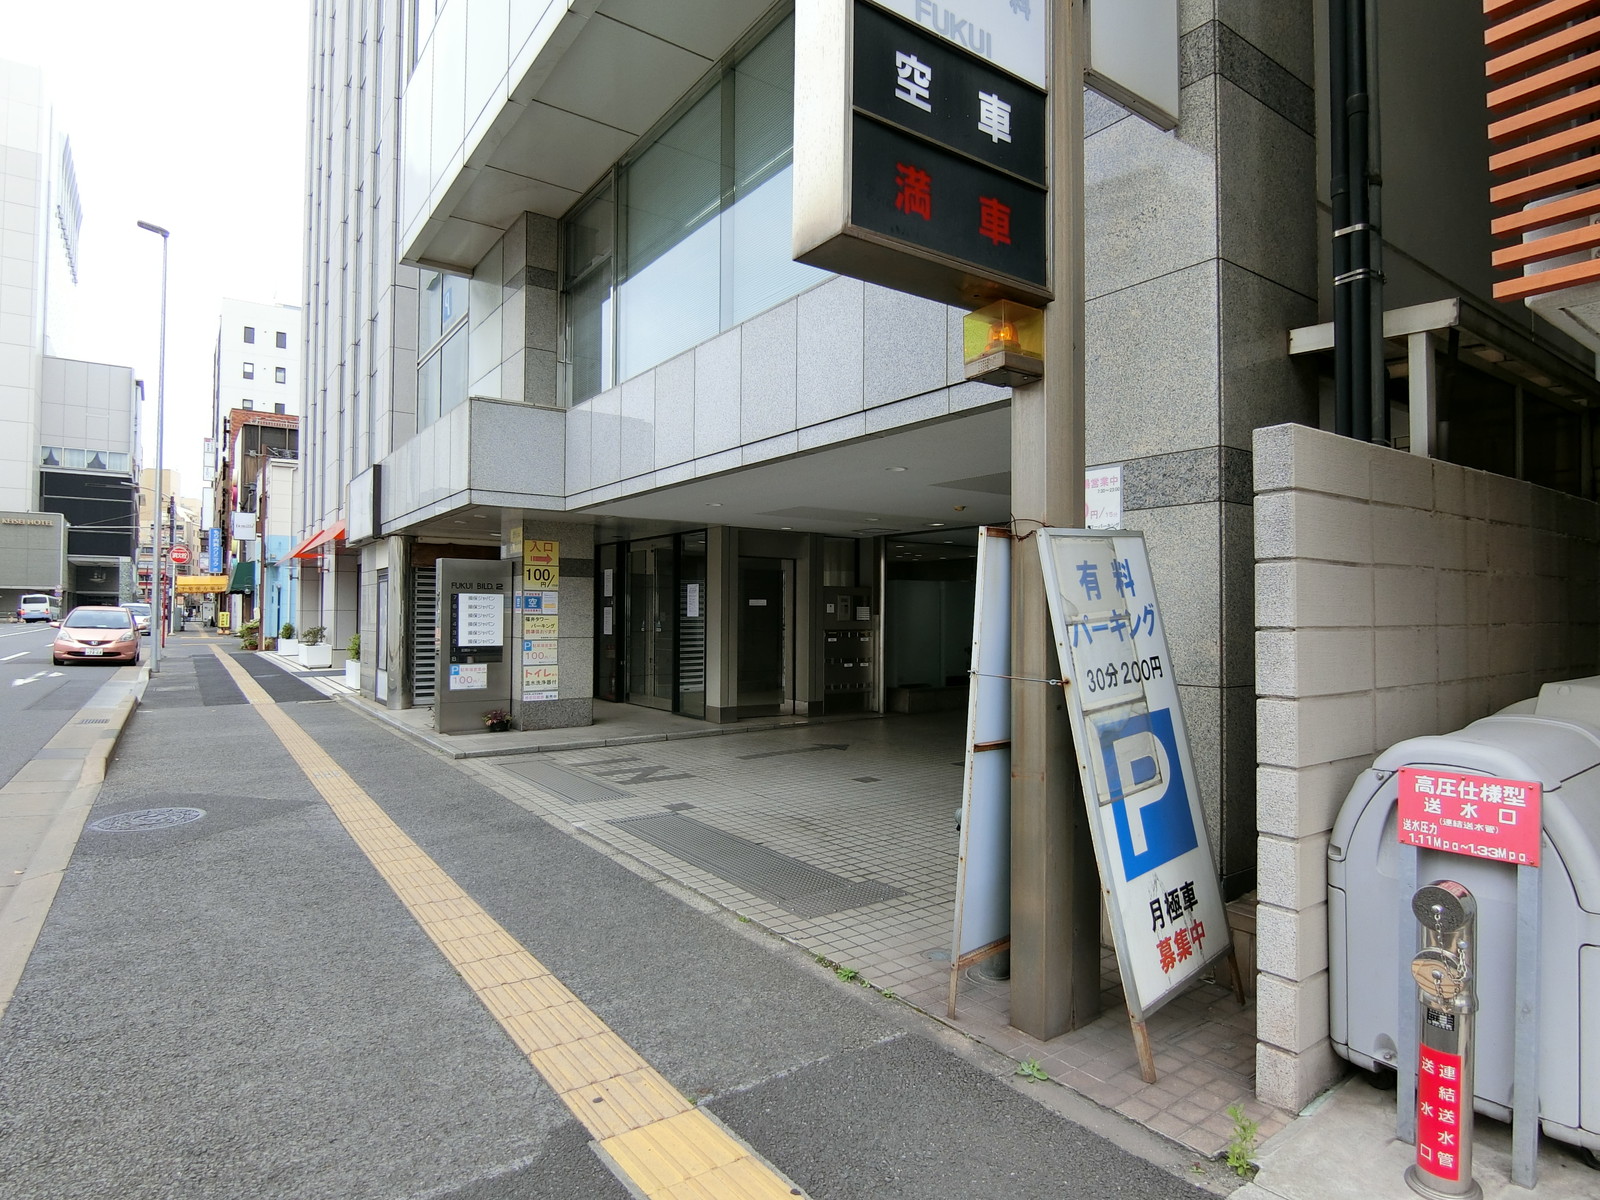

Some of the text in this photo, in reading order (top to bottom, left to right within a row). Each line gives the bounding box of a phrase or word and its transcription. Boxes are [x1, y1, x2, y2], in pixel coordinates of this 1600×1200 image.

[915, 0, 992, 59] FUKUI
[530, 541, 553, 552] 入口
[451, 582, 473, 590] FUKUI
[496, 583, 504, 591] 2
[526, 568, 550, 581] 100
[1076, 559, 1136, 601] 有料
[528, 597, 538, 608] 空
[1073, 603, 1155, 648] パーキング
[526, 651, 545, 660] 100
[526, 668, 552, 678] トイレ
[1414, 775, 1526, 808] 高圧仕様型
[1402, 818, 1438, 835] 送水圧力
[1423, 797, 1517, 826] 送水口
[1149, 880, 1199, 932] 月極車
[1156, 918, 1206, 974] 募集中
[1420, 1056, 1435, 1162] 送水口
[1437, 1064, 1457, 1169] 連結送水管
